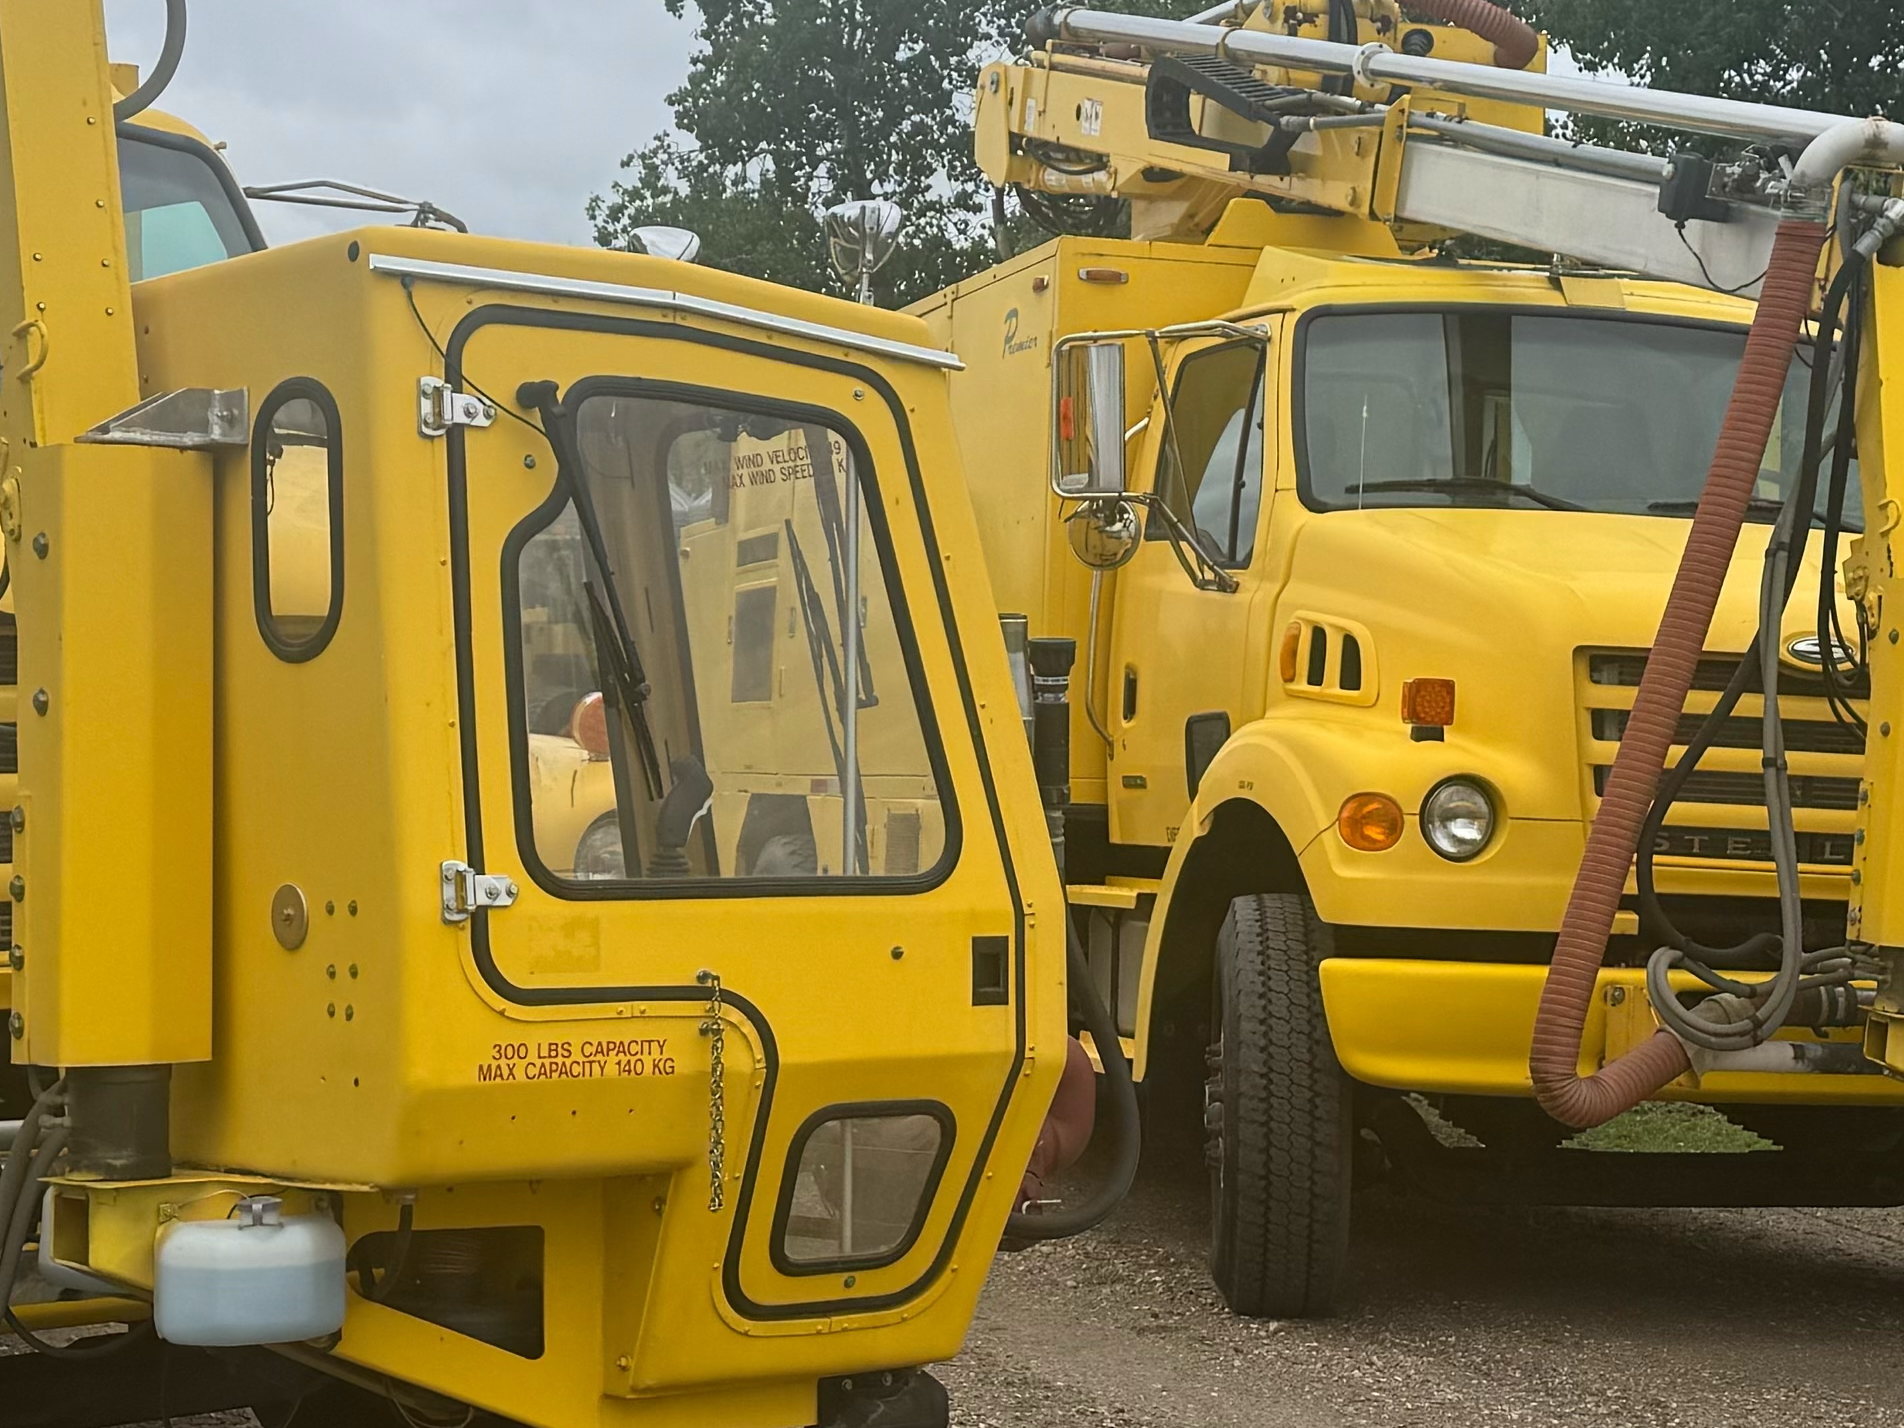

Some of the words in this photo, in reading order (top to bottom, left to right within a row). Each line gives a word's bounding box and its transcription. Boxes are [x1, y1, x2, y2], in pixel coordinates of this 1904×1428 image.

[734, 452, 764, 470] WIND
[767, 445, 809, 465] VELOCI
[726, 474, 745, 489] AX
[749, 469, 776, 486] WIND
[492, 1042, 529, 1060] 300
[537, 1042, 573, 1059] LBS
[581, 1039, 667, 1058] CAPACITY
[478, 1063, 516, 1082] MAX
[524, 1060, 607, 1080] CAPACITY
[615, 1058, 645, 1076] 140
[652, 1057, 675, 1075] KG
